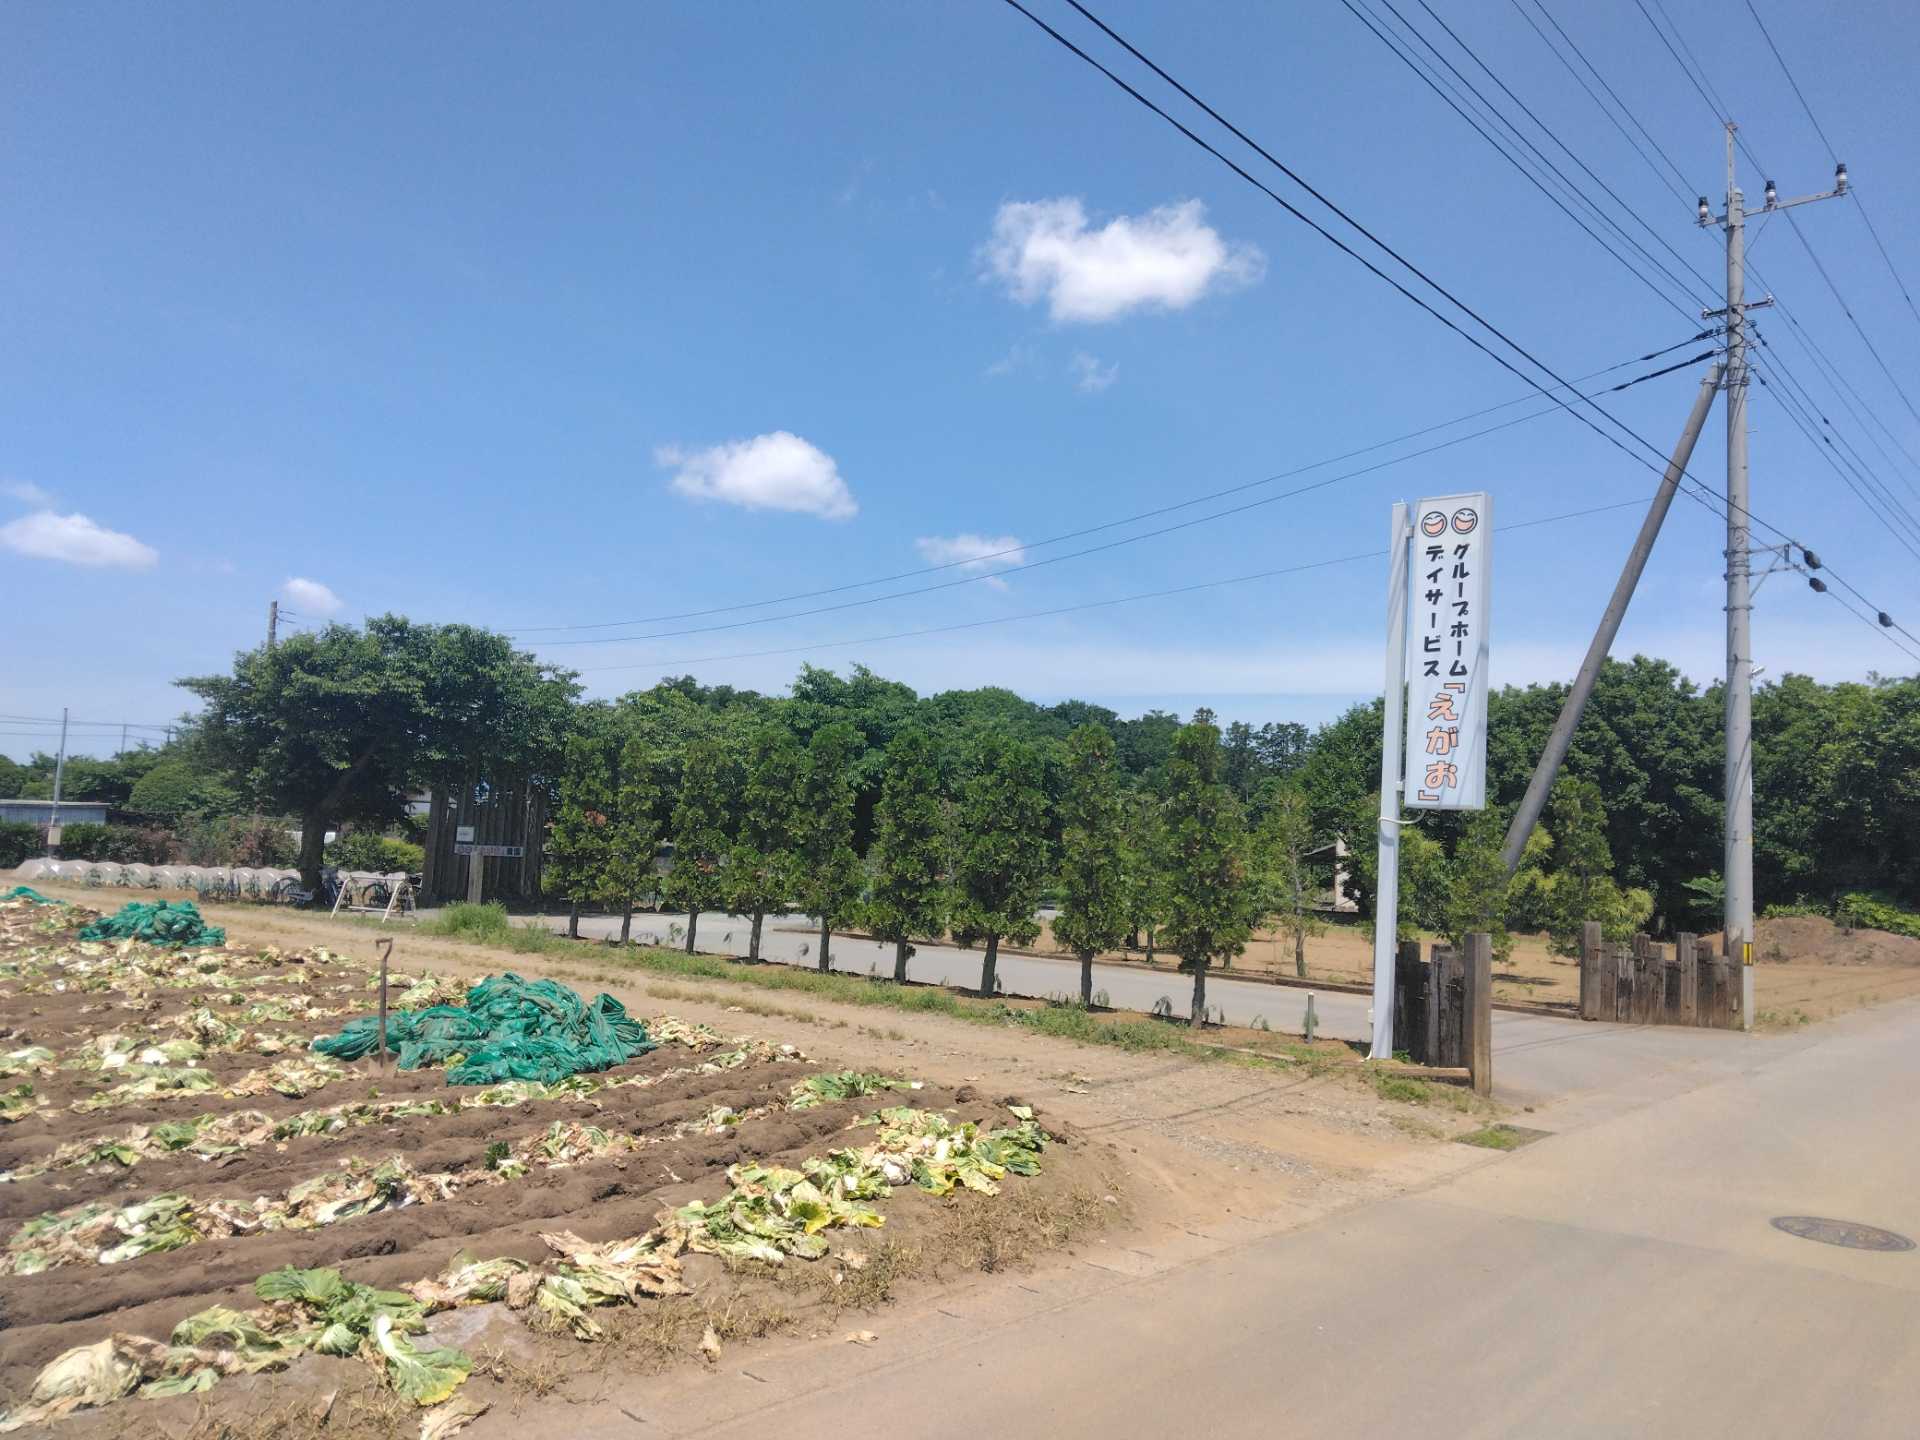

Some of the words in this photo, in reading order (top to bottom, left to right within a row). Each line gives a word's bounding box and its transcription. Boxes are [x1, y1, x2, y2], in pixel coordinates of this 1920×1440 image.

[1423, 545, 1444, 677] デイサービス
[1449, 543, 1471, 677] グループホーム
